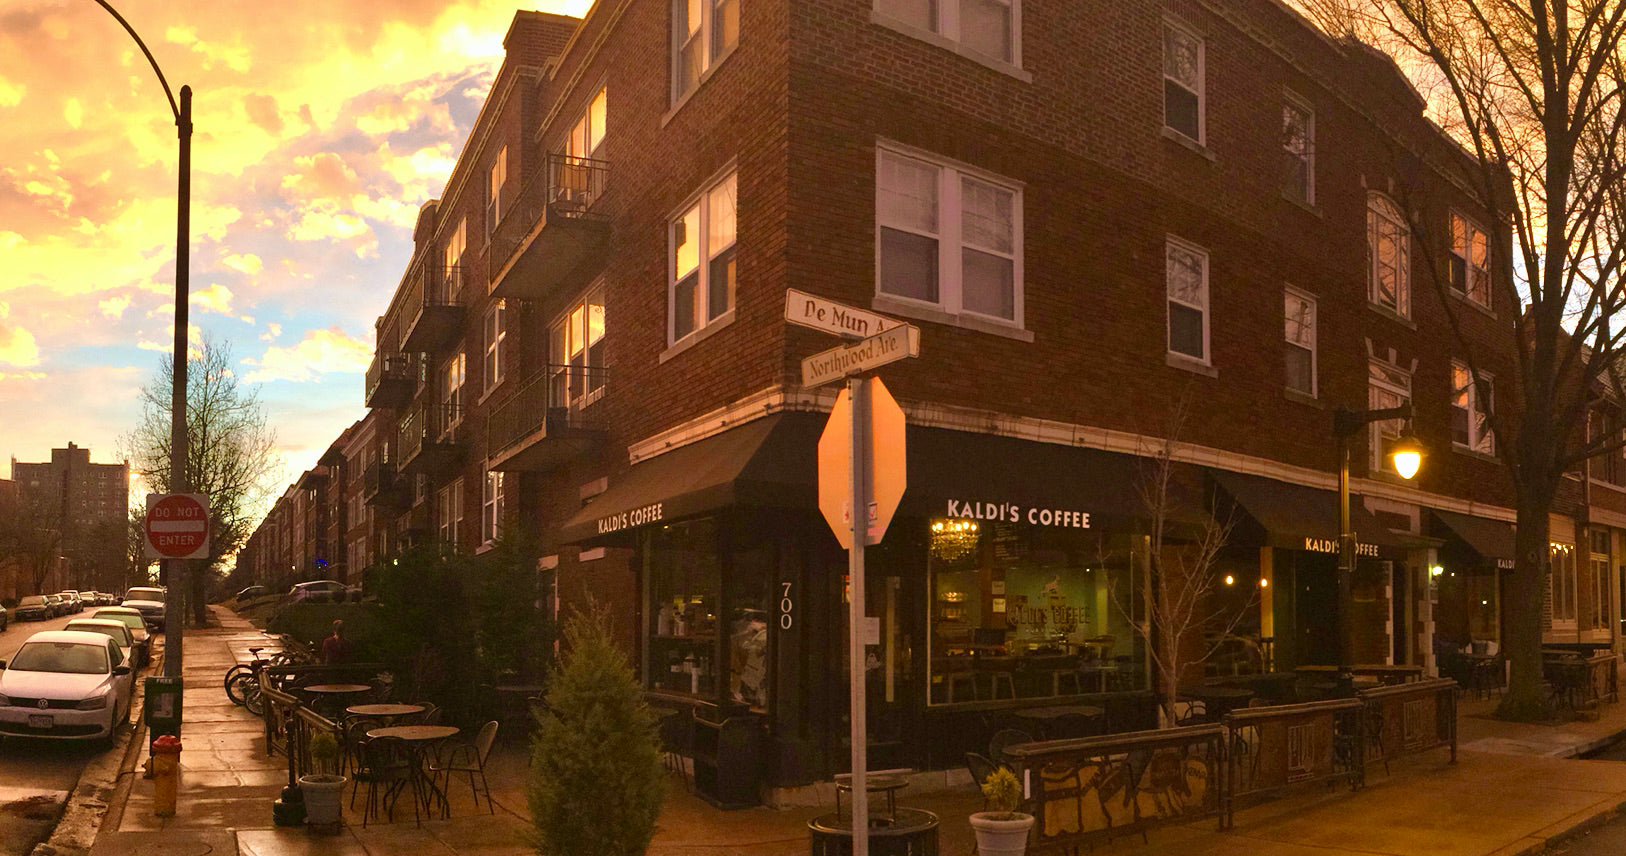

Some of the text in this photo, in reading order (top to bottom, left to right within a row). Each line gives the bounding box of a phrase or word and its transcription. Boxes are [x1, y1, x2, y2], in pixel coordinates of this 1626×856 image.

[804, 300, 826, 321] De
[831, 307, 868, 336] Mun
[809, 339, 874, 379] Northwood
[155, 506, 200, 518] DO NOT
[598, 503, 663, 534] KALDI'S COFFEE
[947, 499, 1091, 529] KALDI'S COFFEE
[159, 535, 195, 546] ENTER
[1354, 542, 1379, 557] OFFEE
[1497, 559, 1515, 569] KALDI
[781, 582, 793, 630] 700
